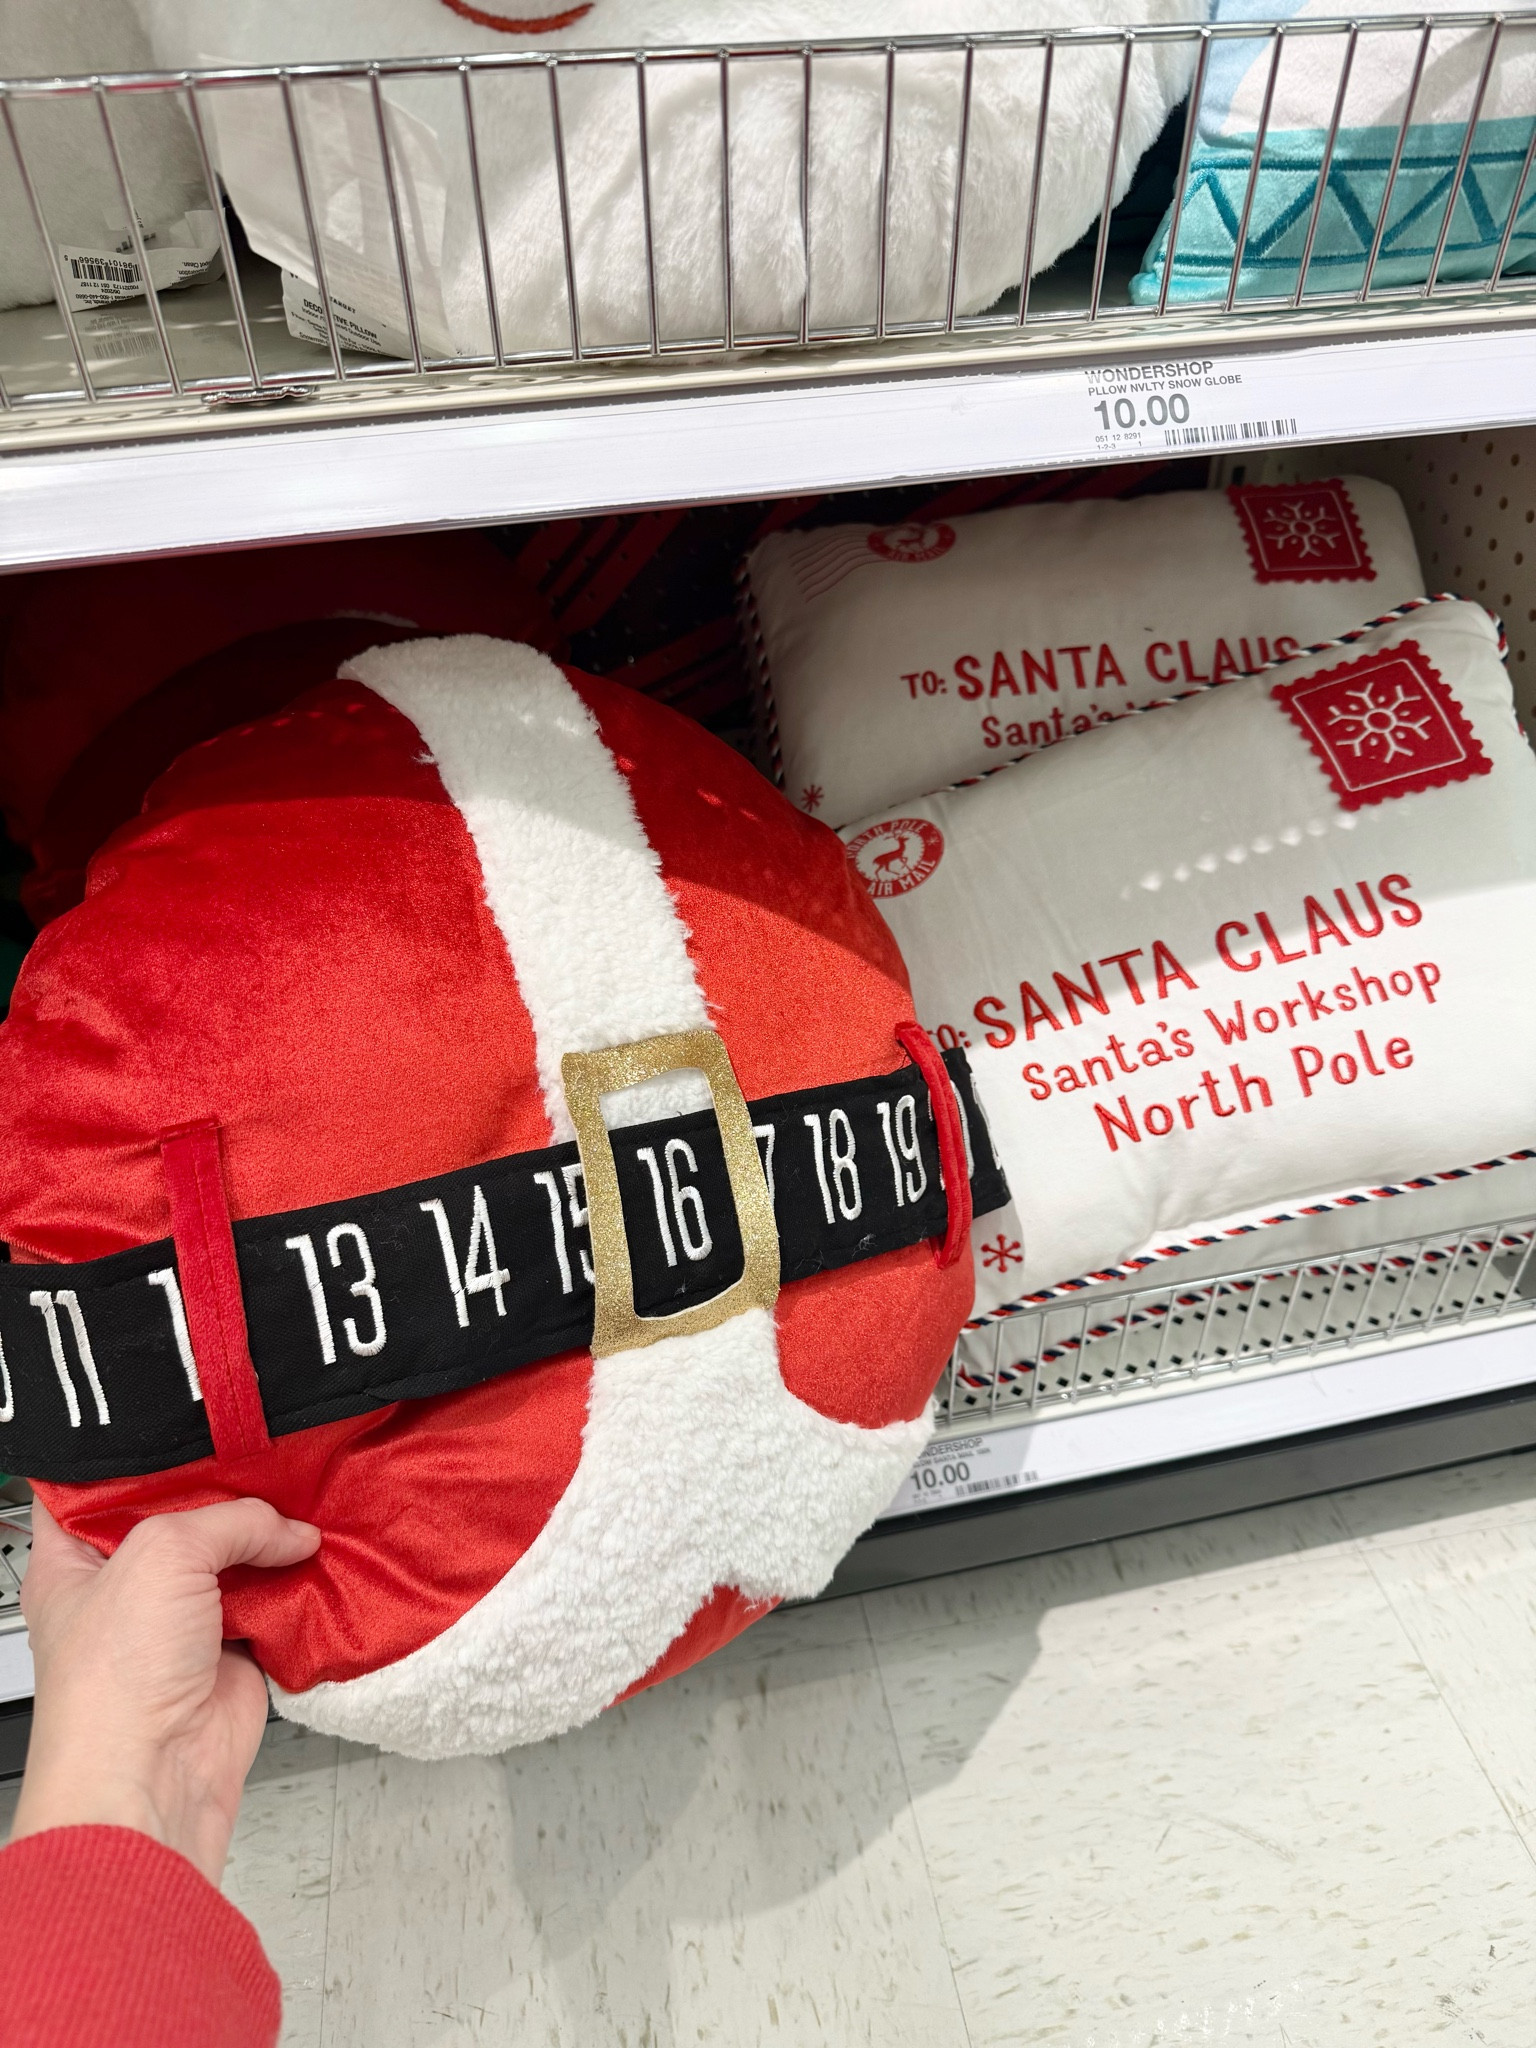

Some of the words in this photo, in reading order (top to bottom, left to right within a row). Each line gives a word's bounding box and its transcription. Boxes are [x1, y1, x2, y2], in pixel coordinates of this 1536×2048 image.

[79, 256, 105, 266] 39566
[108, 259, 133, 269] 98101
[303, 298, 349, 327] DECOTIVE
[349, 321, 378, 339] PILLOW
[1085, 360, 1214, 385] WONDERSHOP
[1088, 384, 1128, 397] PLLOW
[1130, 381, 1165, 393] NVLTY
[1168, 378, 1202, 390] SNOW
[1204, 374, 1243, 387] GLOBE
[1094, 393, 1190, 431] 10.00
[1095, 434, 1109, 443] 051
[1112, 433, 1121, 442] 12
[1124, 432, 1141, 441] 8291
[901, 670, 948, 700] TO:
[954, 643, 1127, 701] SANTA
[867, 881, 893, 896] AIR
[898, 859, 937, 891] MAIL
[926, 1024, 972, 1051] O:
[973, 940, 1200, 1049] SANTA
[1215, 874, 1423, 973] CLAUS
[1022, 1022, 1195, 1101] Santa's
[1204, 962, 1442, 1047] Workshop
[1094, 1064, 1274, 1151] North
[1291, 1030, 1414, 1098] Pole
[30, 1290, 111, 1427] 11
[286, 1222, 387, 1365] 13
[419, 1186, 511, 1328] 14
[637, 1138, 713, 1268] 16
[804, 1108, 863, 1224] 18
[876, 1094, 928, 1207] 19
[917, 1437, 983, 1459] NDERSHOP
[910, 1461, 970, 1491] 10.00
